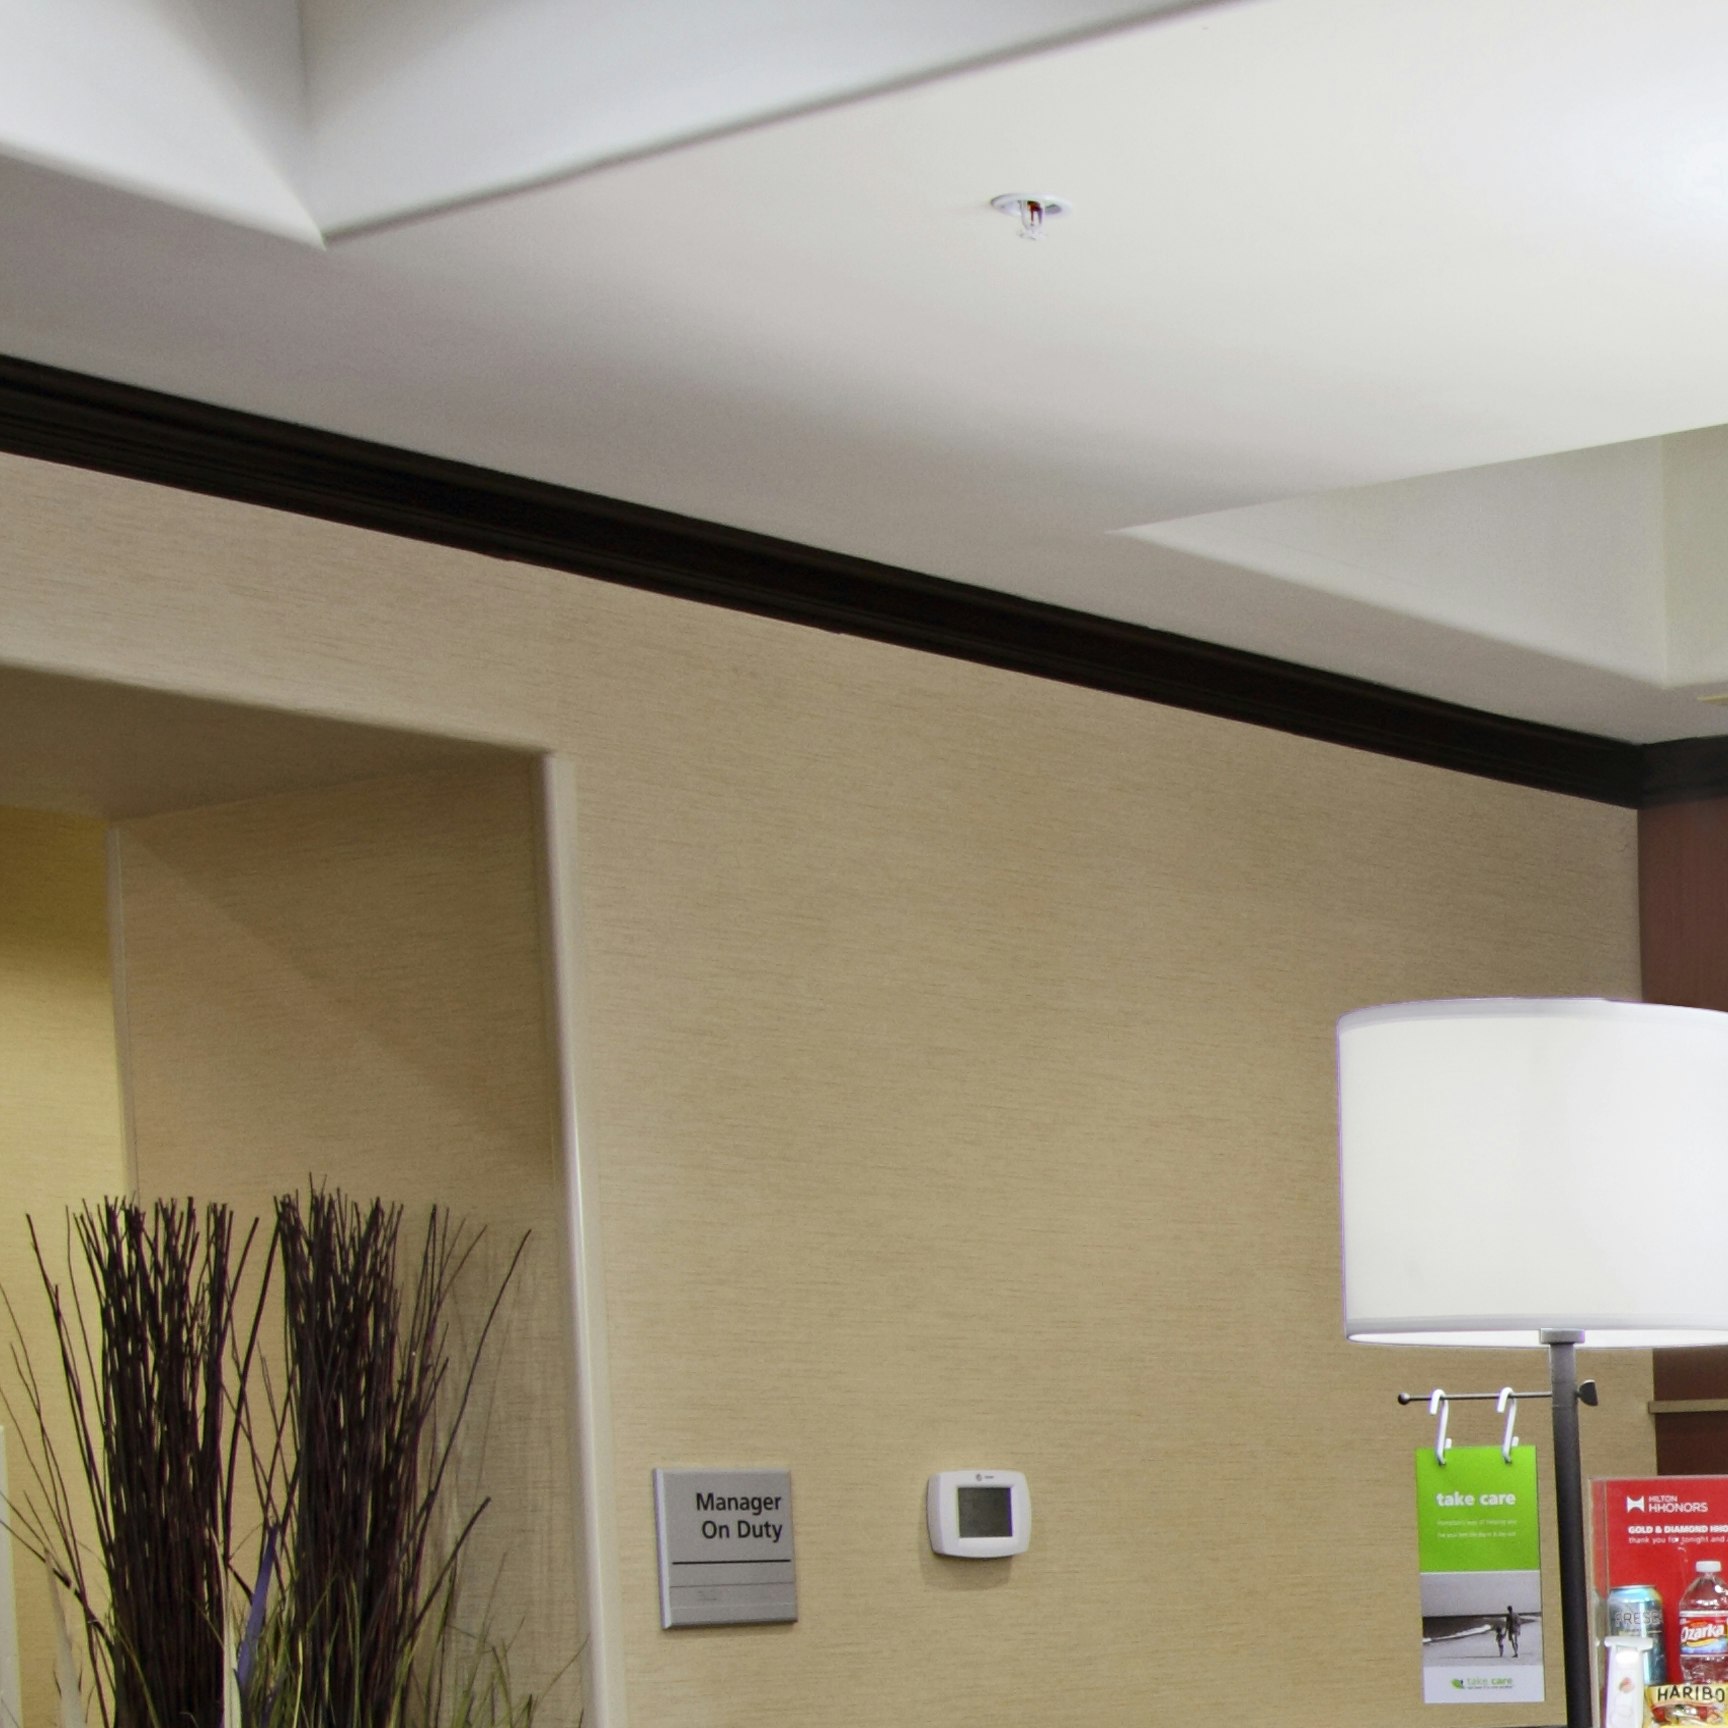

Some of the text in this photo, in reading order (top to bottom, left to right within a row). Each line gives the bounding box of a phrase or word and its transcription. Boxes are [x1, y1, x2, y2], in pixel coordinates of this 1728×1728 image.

[695, 1491, 783, 1516] Manager
[1436, 1491, 1517, 1506] take care
[1648, 1495, 1678, 1503] HILTON
[1648, 1502, 1709, 1513] HHONORS
[702, 1520, 783, 1543] On Duty
[1628, 1525, 1653, 1534] GOLD
[1664, 1525, 1708, 1533] DIAMOND
[1628, 1535, 1650, 1544] thank
[1657, 1684, 1725, 1703] HARIBO
